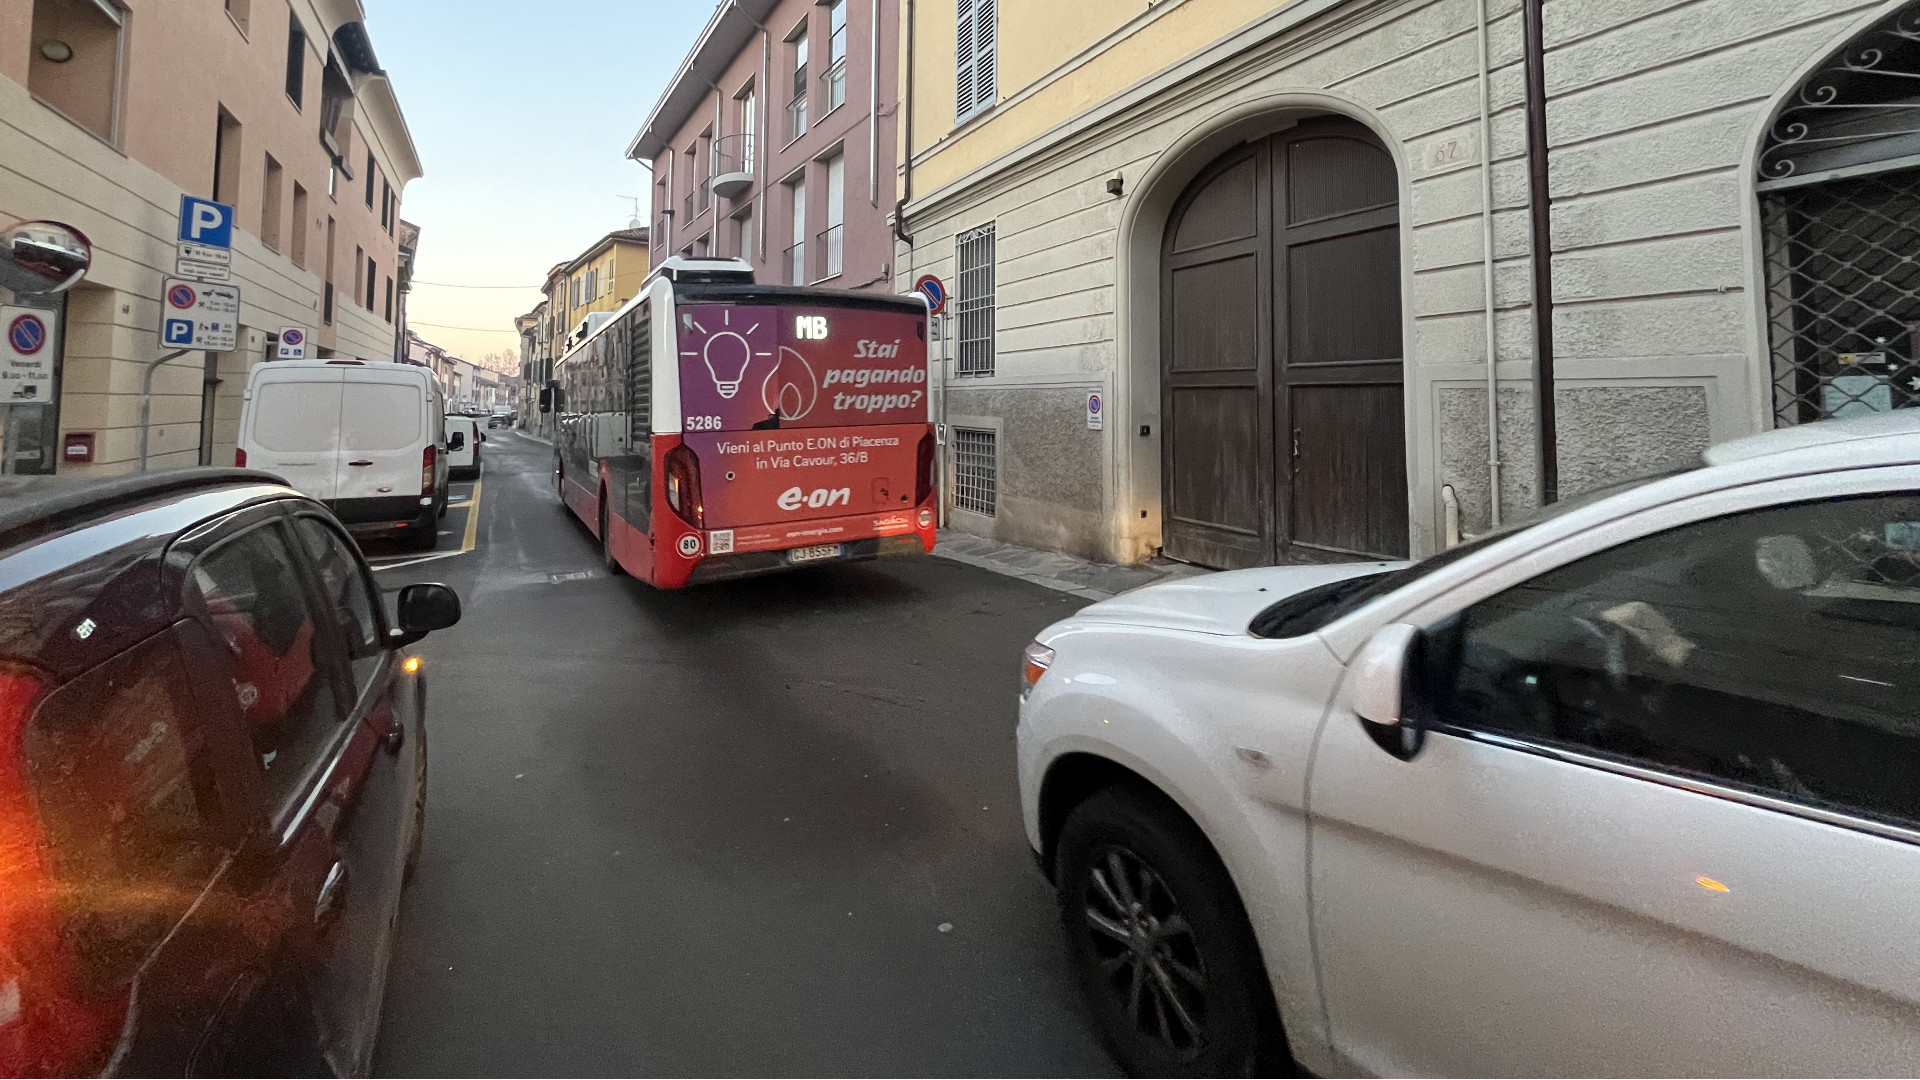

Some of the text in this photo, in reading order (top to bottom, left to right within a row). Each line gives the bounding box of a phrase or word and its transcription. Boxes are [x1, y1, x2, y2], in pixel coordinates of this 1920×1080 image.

[190, 202, 223, 239] P
[171, 322, 188, 340] P
[796, 315, 828, 340] MB
[854, 339, 900, 359] Stai
[822, 365, 926, 389] pagando
[833, 390, 922, 414] troppo?
[686, 415, 722, 430] 5286
[717, 436, 899, 455] Vieni al Punto E.ON di Piacenza
[756, 452, 868, 469] in Via Cavour, 36/B
[683, 539, 696, 550] 80
